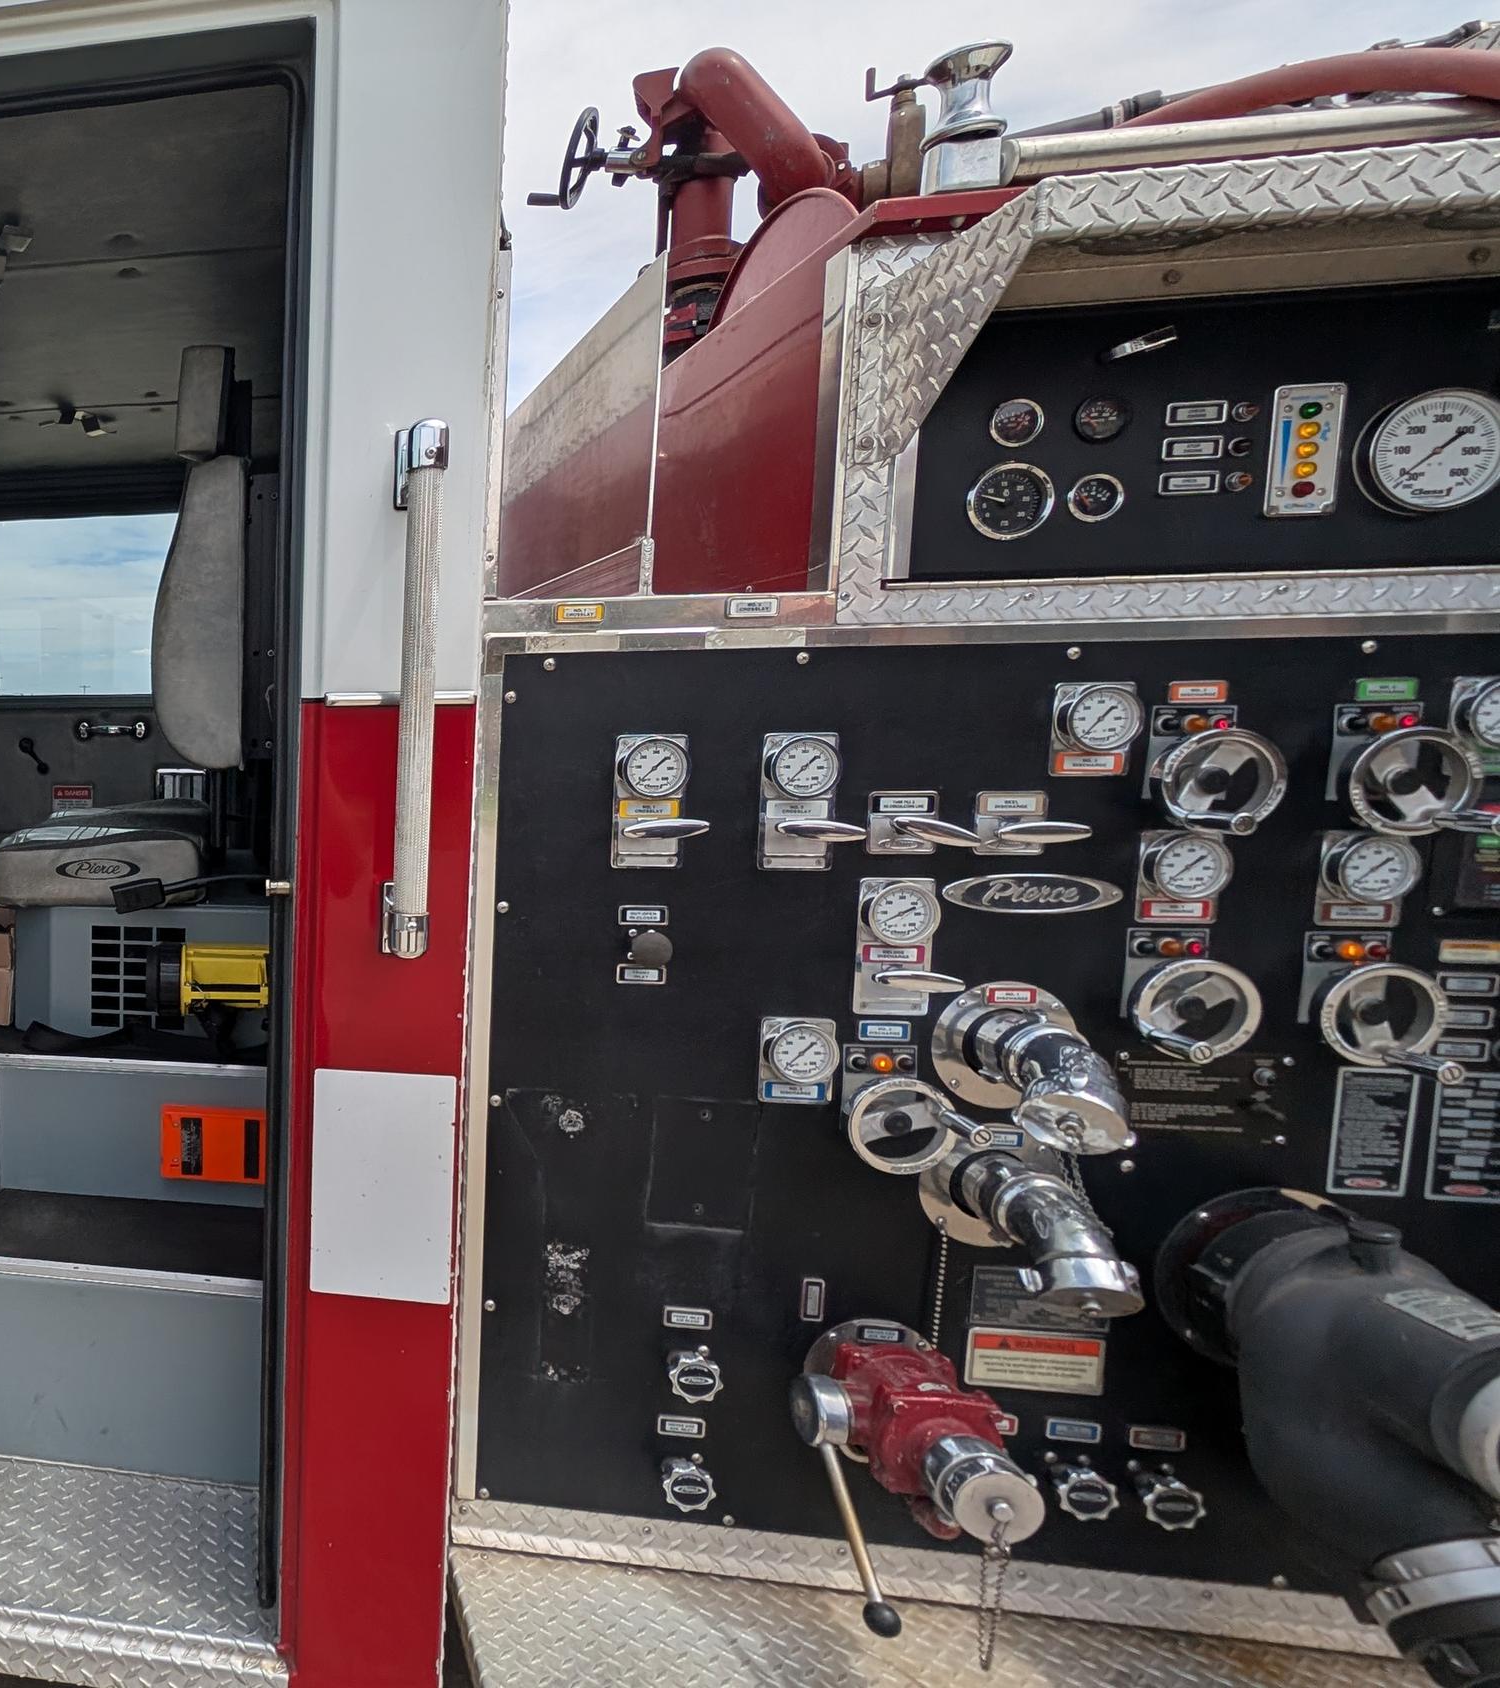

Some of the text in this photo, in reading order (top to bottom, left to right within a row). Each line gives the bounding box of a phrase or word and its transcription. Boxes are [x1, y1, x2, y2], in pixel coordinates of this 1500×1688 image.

[1432, 414, 1453, 423] 300
[1406, 426, 1426, 435] 200
[1455, 426, 1475, 435] 400
[1394, 446, 1411, 455] 100
[1461, 446, 1480, 455] 500
[1449, 468, 1468, 477] 600
[75, 861, 121, 876] Pierce
[982, 878, 1080, 906] Pierce
